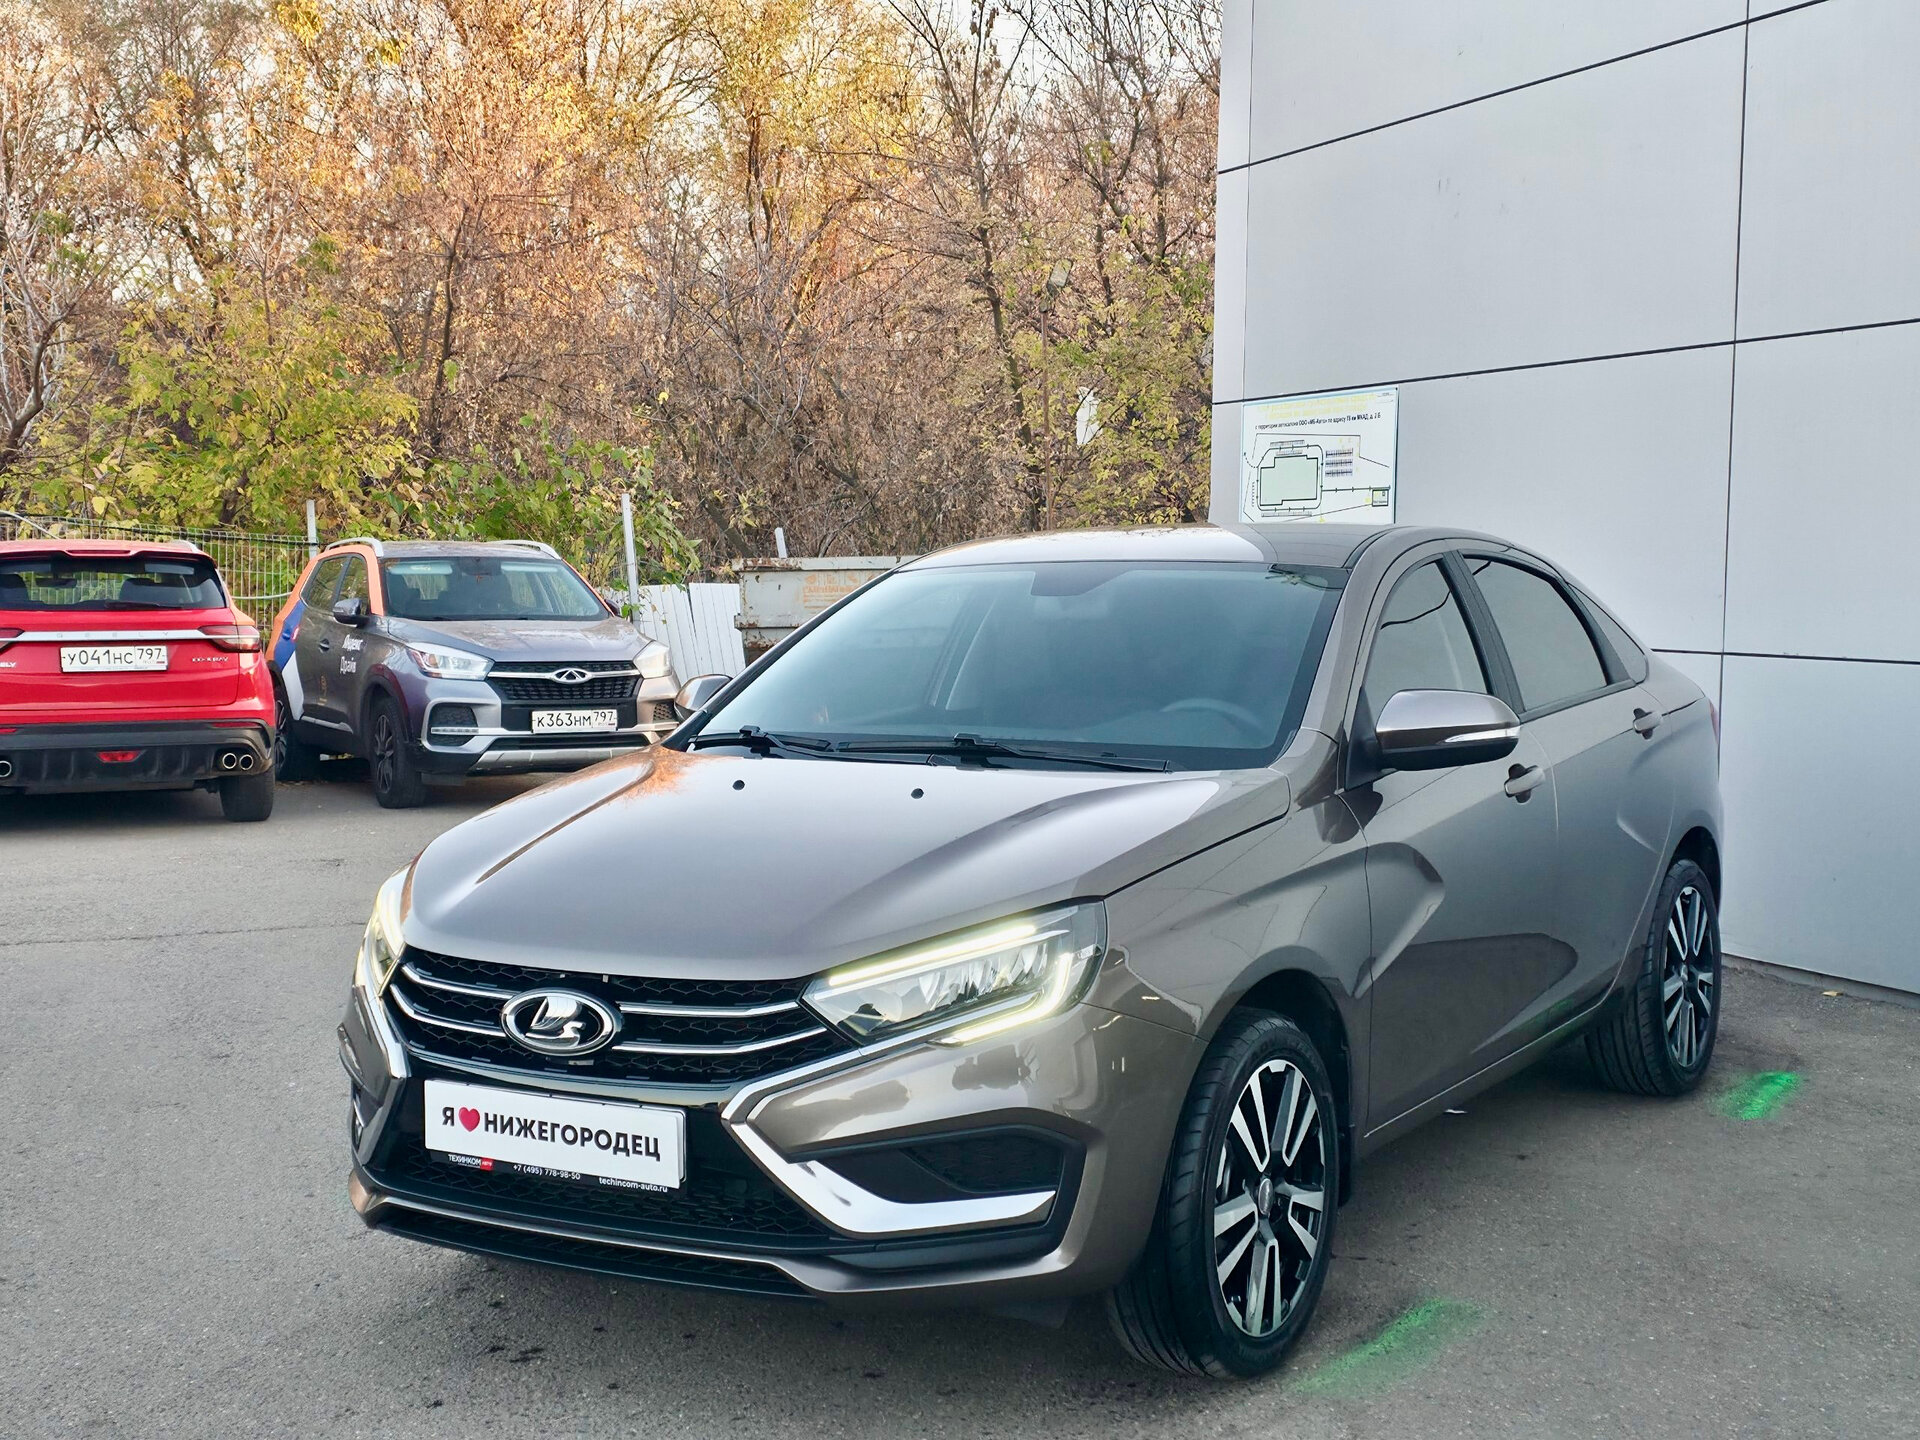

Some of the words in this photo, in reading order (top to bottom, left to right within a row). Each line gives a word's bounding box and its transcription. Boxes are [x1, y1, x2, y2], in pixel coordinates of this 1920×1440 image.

[442, 1106, 455, 1127] Я
[484, 1112, 661, 1162] НИЖЕГОРОДЕЦ
[448, 1153, 481, 1167] ТЕХИНКОМ
[513, 1164, 521, 1172] +7
[523, 1166, 543, 1176] (495)
[545, 1168, 581, 1180] 778-98-50
[599, 1177, 668, 1192] techincom-auto.ru
